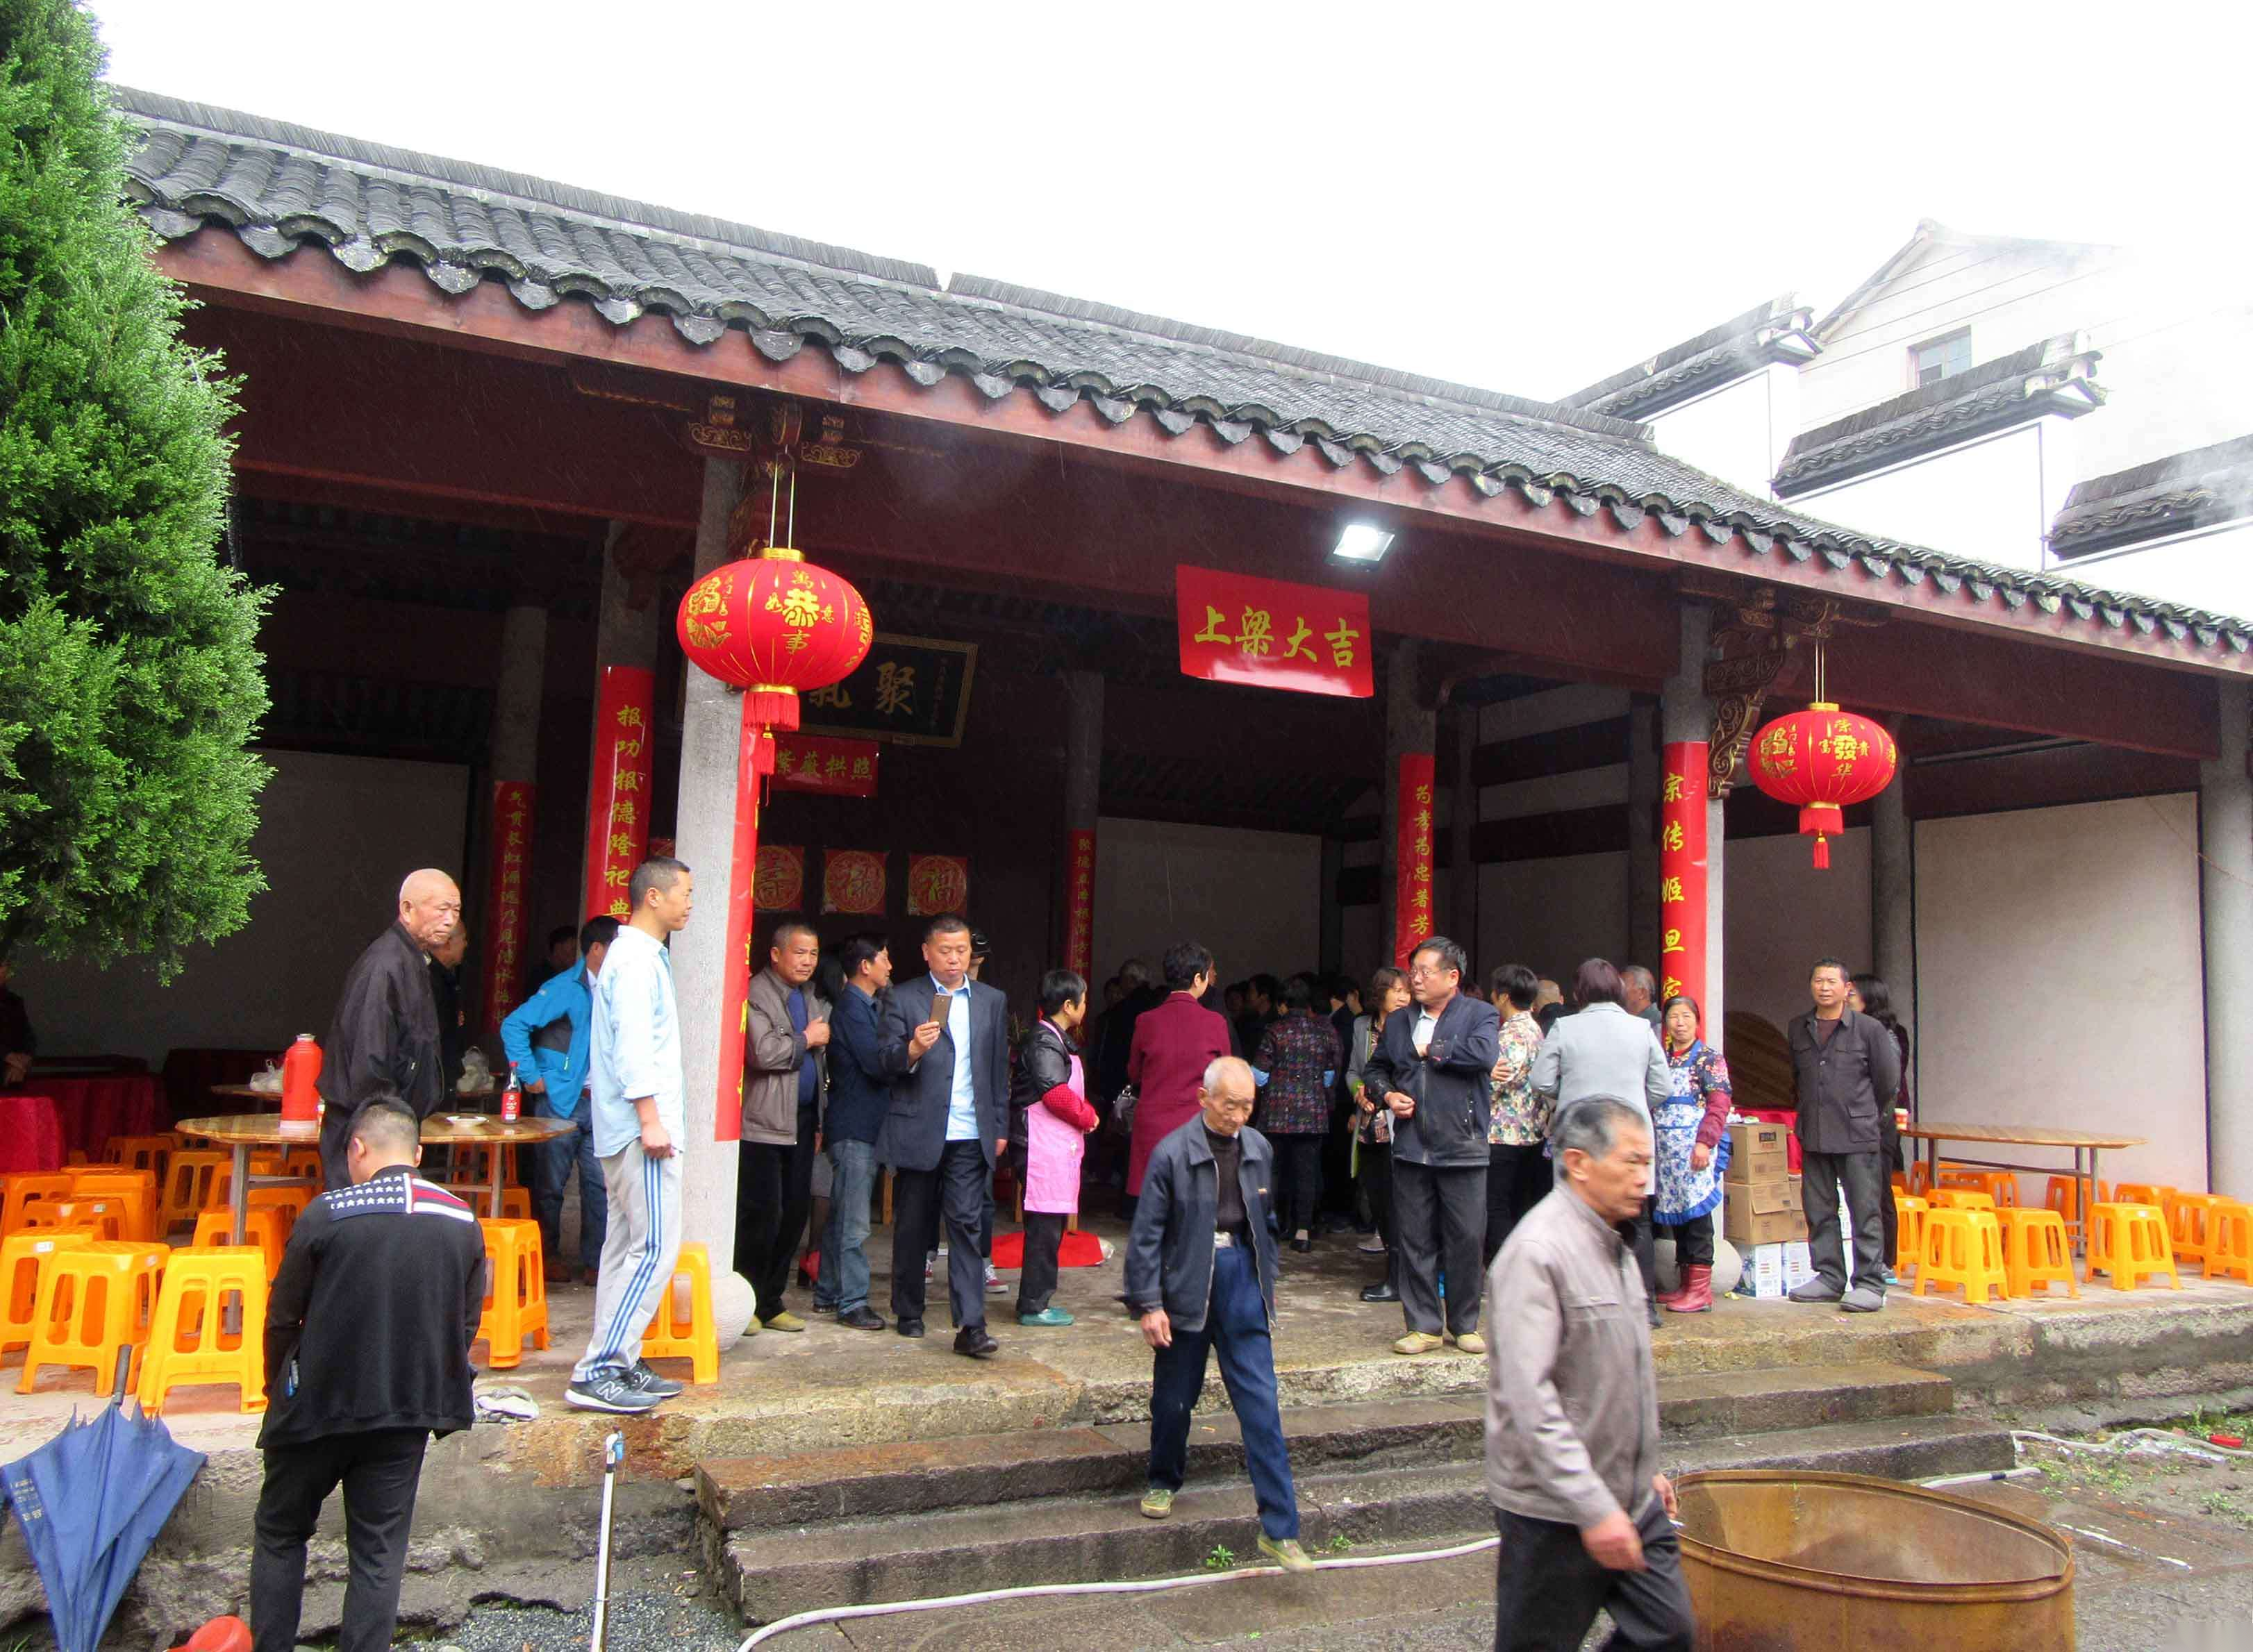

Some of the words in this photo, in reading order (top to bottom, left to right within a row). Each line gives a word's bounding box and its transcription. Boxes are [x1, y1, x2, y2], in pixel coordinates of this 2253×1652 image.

[782, 587, 820, 628] 恭
[1194, 605, 1360, 667] 上梁大吉
[1409, 784, 1433, 942] 为孝为忠著芳
[595, 1381, 624, 1401] N
